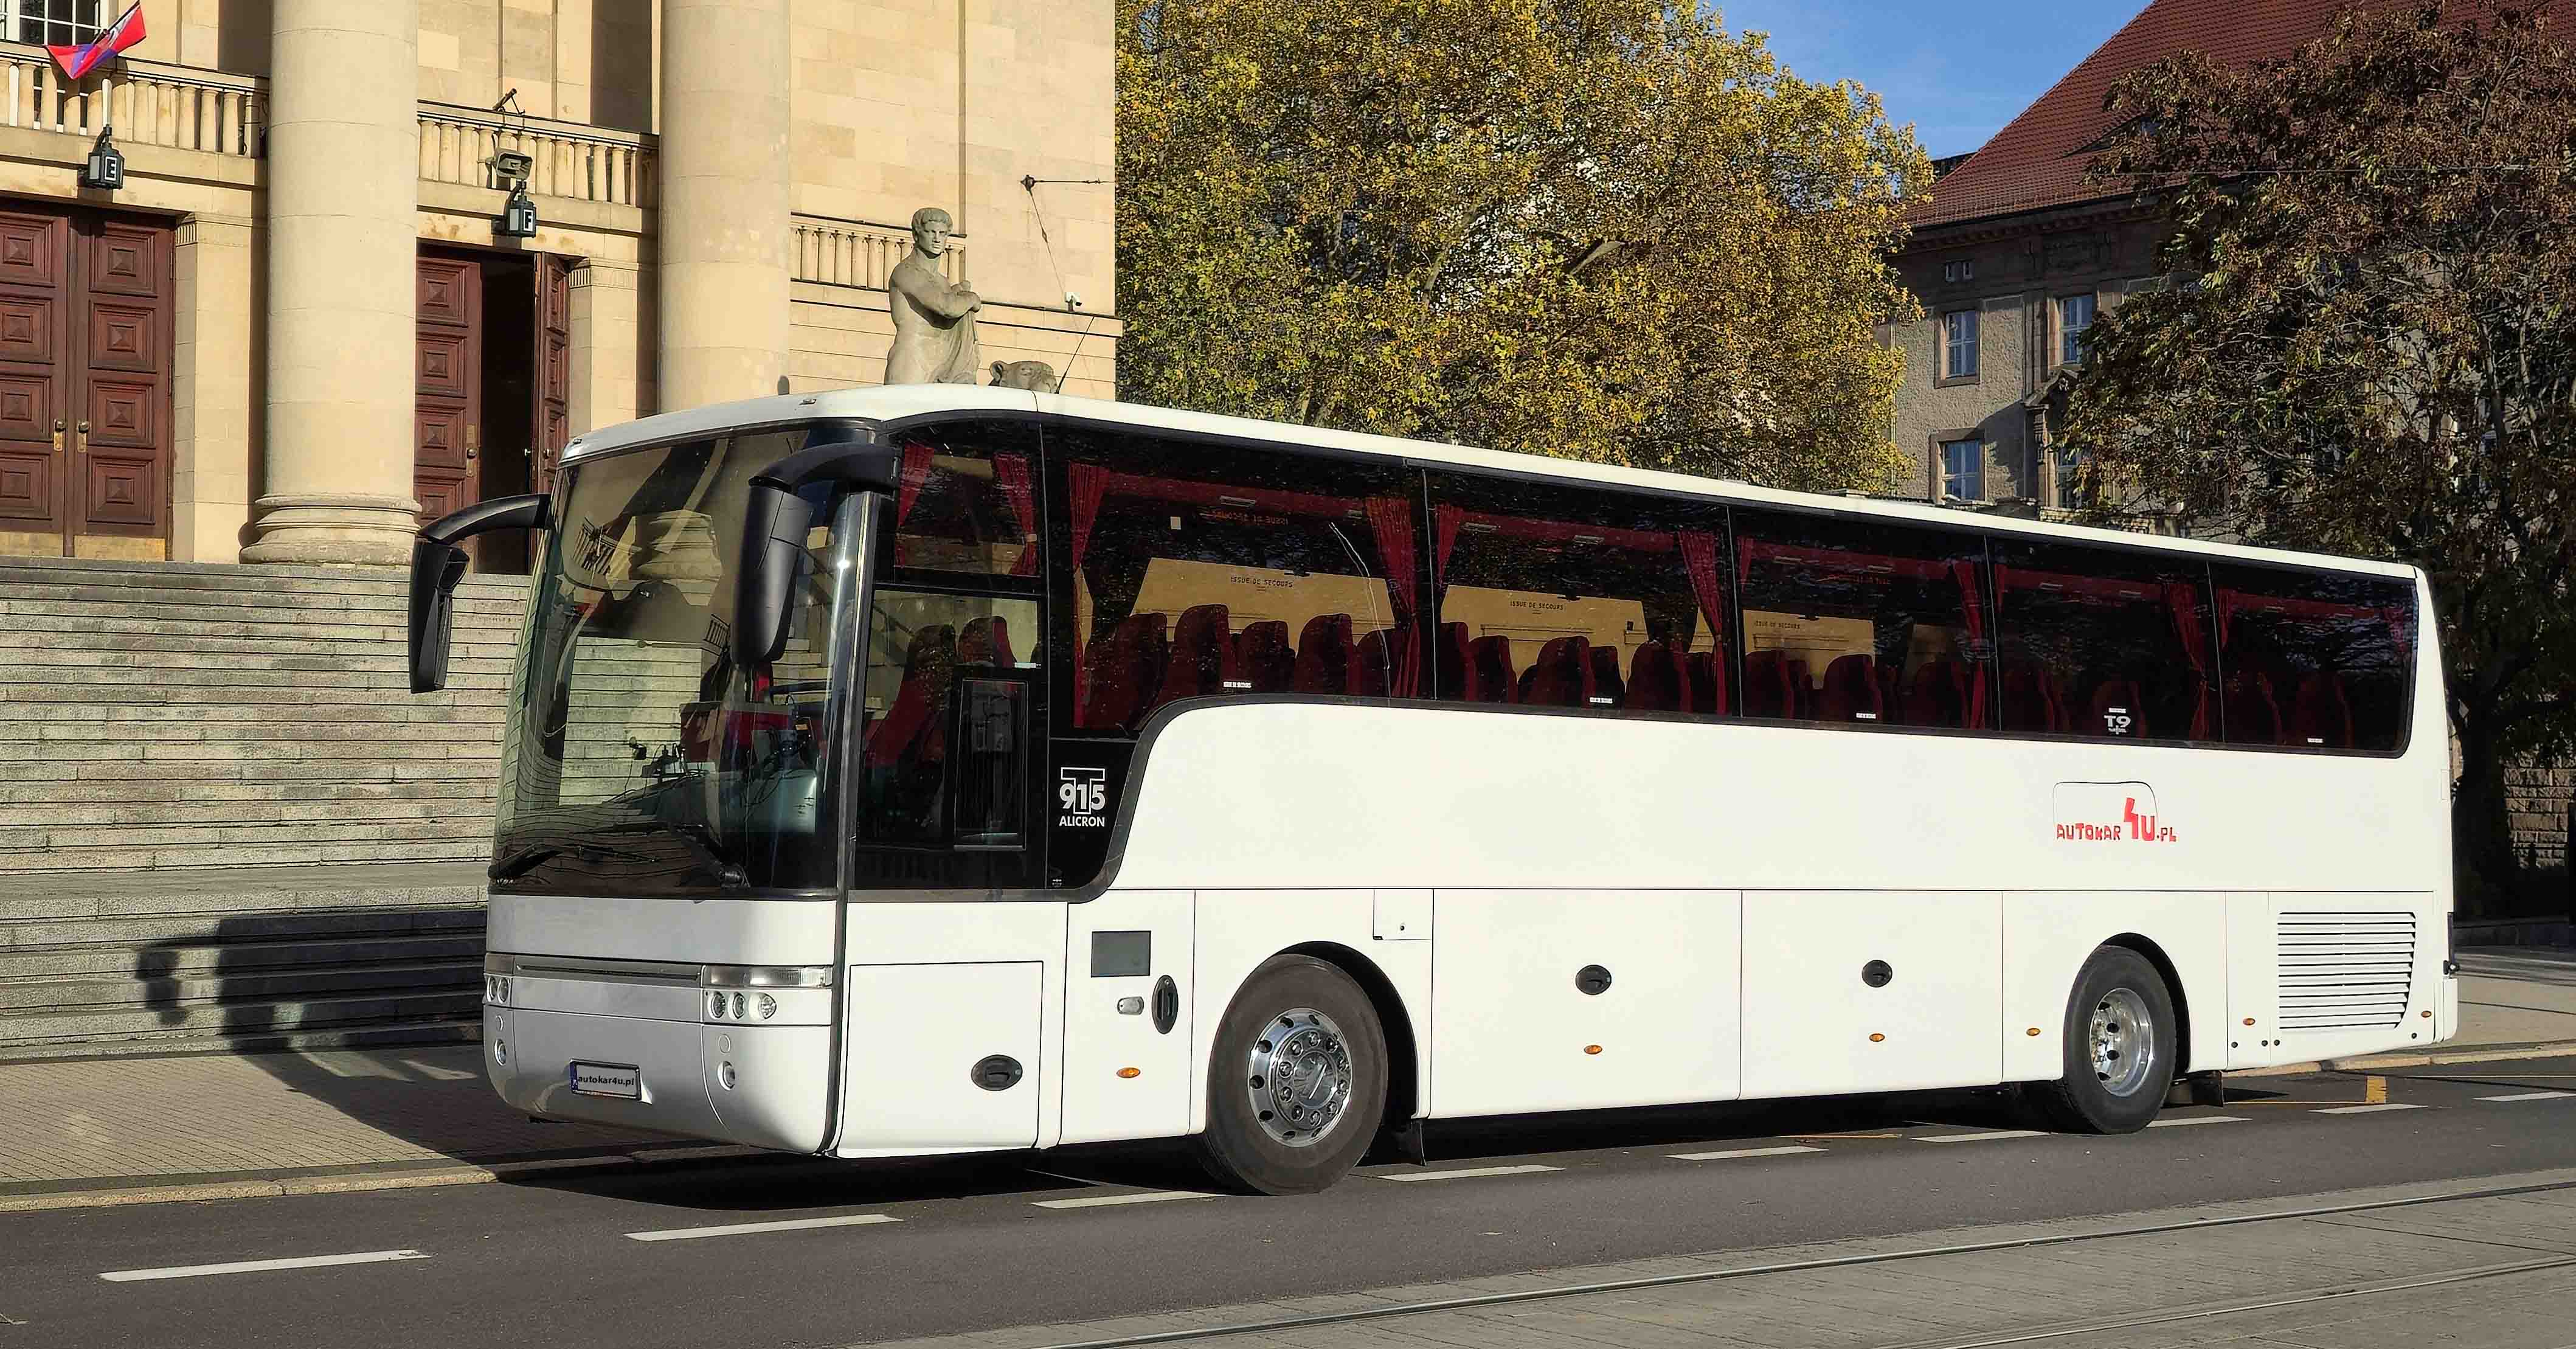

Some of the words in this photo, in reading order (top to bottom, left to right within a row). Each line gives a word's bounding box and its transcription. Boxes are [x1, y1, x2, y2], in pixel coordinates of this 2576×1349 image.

[106, 159, 116, 178] E
[525, 211, 532, 229] F
[2103, 715, 2131, 727] T9
[1059, 783, 1106, 810] 915
[1059, 816, 1105, 827] ALICRON
[578, 1075, 635, 1087] autokar4u.pl
